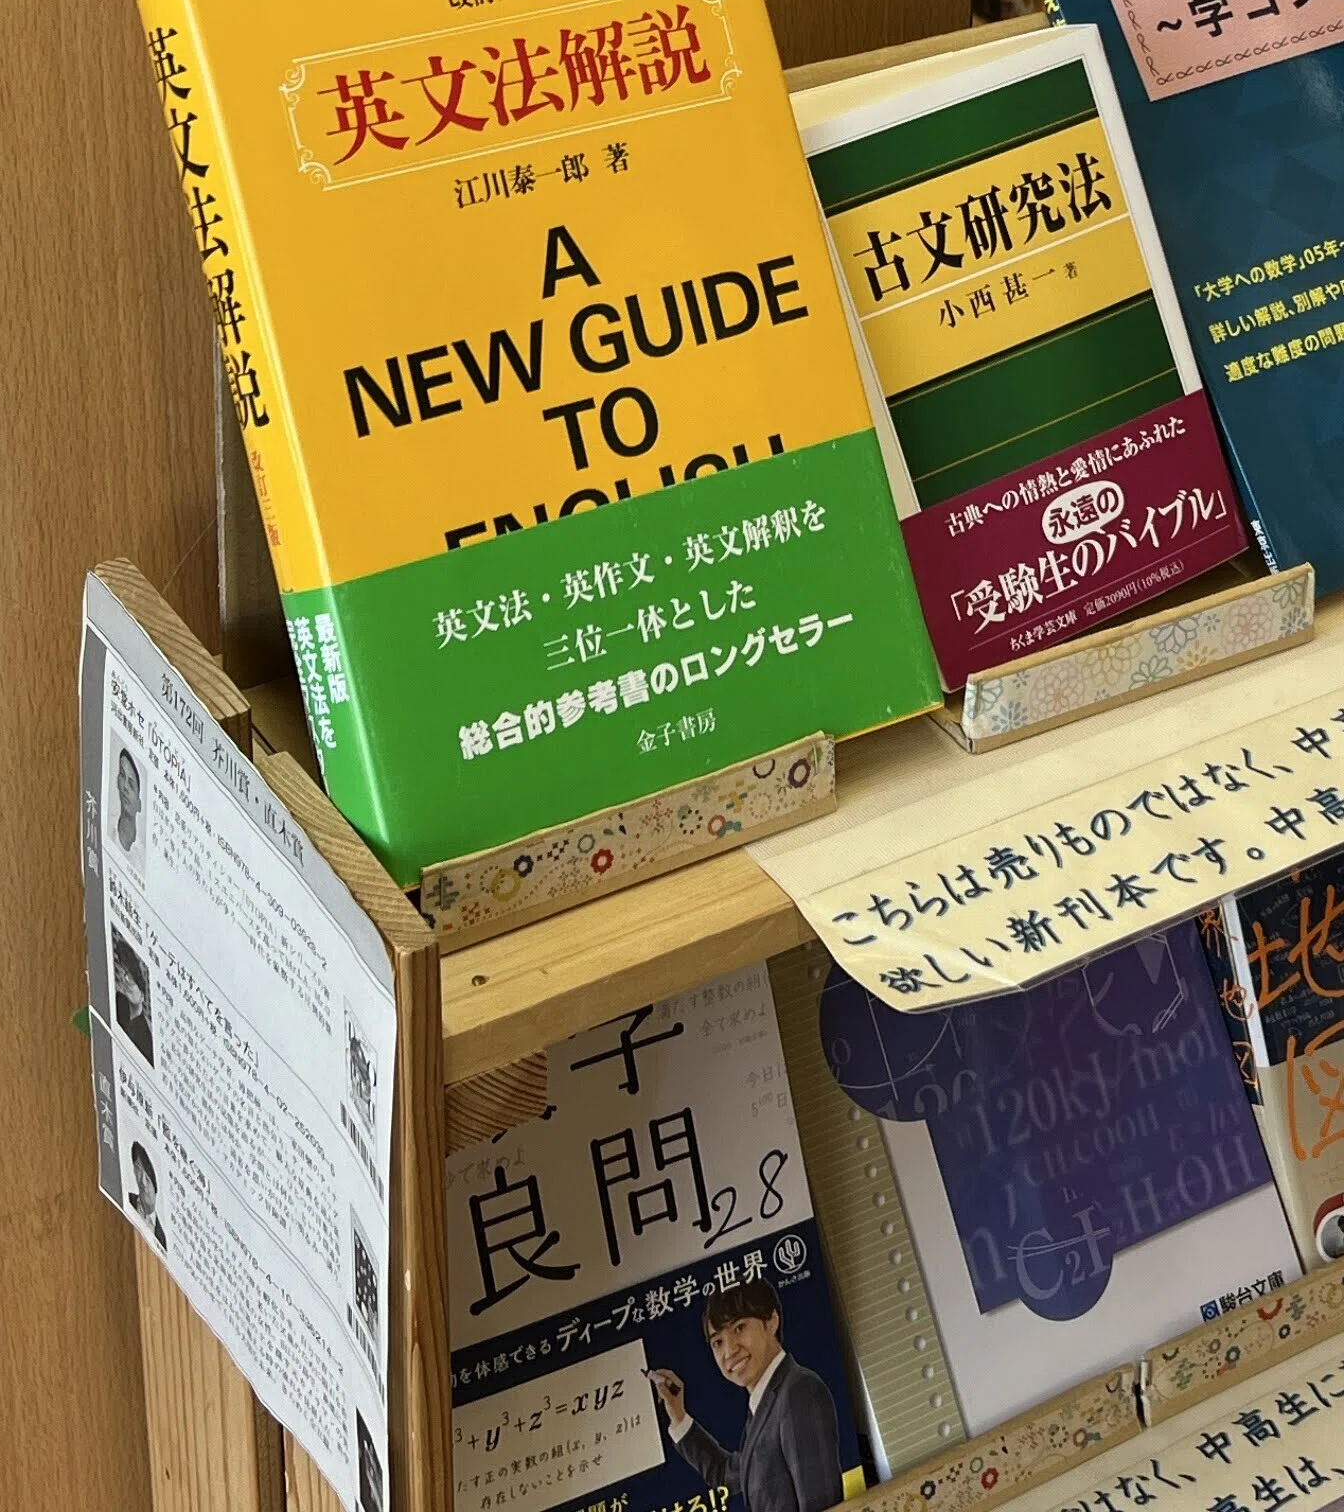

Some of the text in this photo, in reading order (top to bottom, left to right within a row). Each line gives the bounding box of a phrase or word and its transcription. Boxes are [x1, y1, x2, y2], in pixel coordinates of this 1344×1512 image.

[317, 4, 713, 167] 英文法解説
[453, 142, 632, 210] 江川泰一郎 著
[542, 224, 601, 300] A
[853, 151, 1112, 302] 古文研究法
[938, 261, 1079, 330] 小西甚一 著
[343, 256, 810, 439] NEW GUIDE
[542, 386, 661, 473] TO
[943, 416, 1187, 538] 古典への情熱と愛情にあふれた
[1047, 490, 1121, 540] 永遠の
[432, 497, 828, 651] 英文法・英作文・英文解釈を
[948, 486, 1228, 633] 「受験生のバイブル」
[314, 612, 350, 704] 最新版
[544, 578, 758, 672] 三位一体とした
[1010, 609, 1078, 652] ちくま学芸文庫
[458, 610, 855, 761] 総合的参考書のロングセラー
[636, 708, 718, 755] 金子書房
